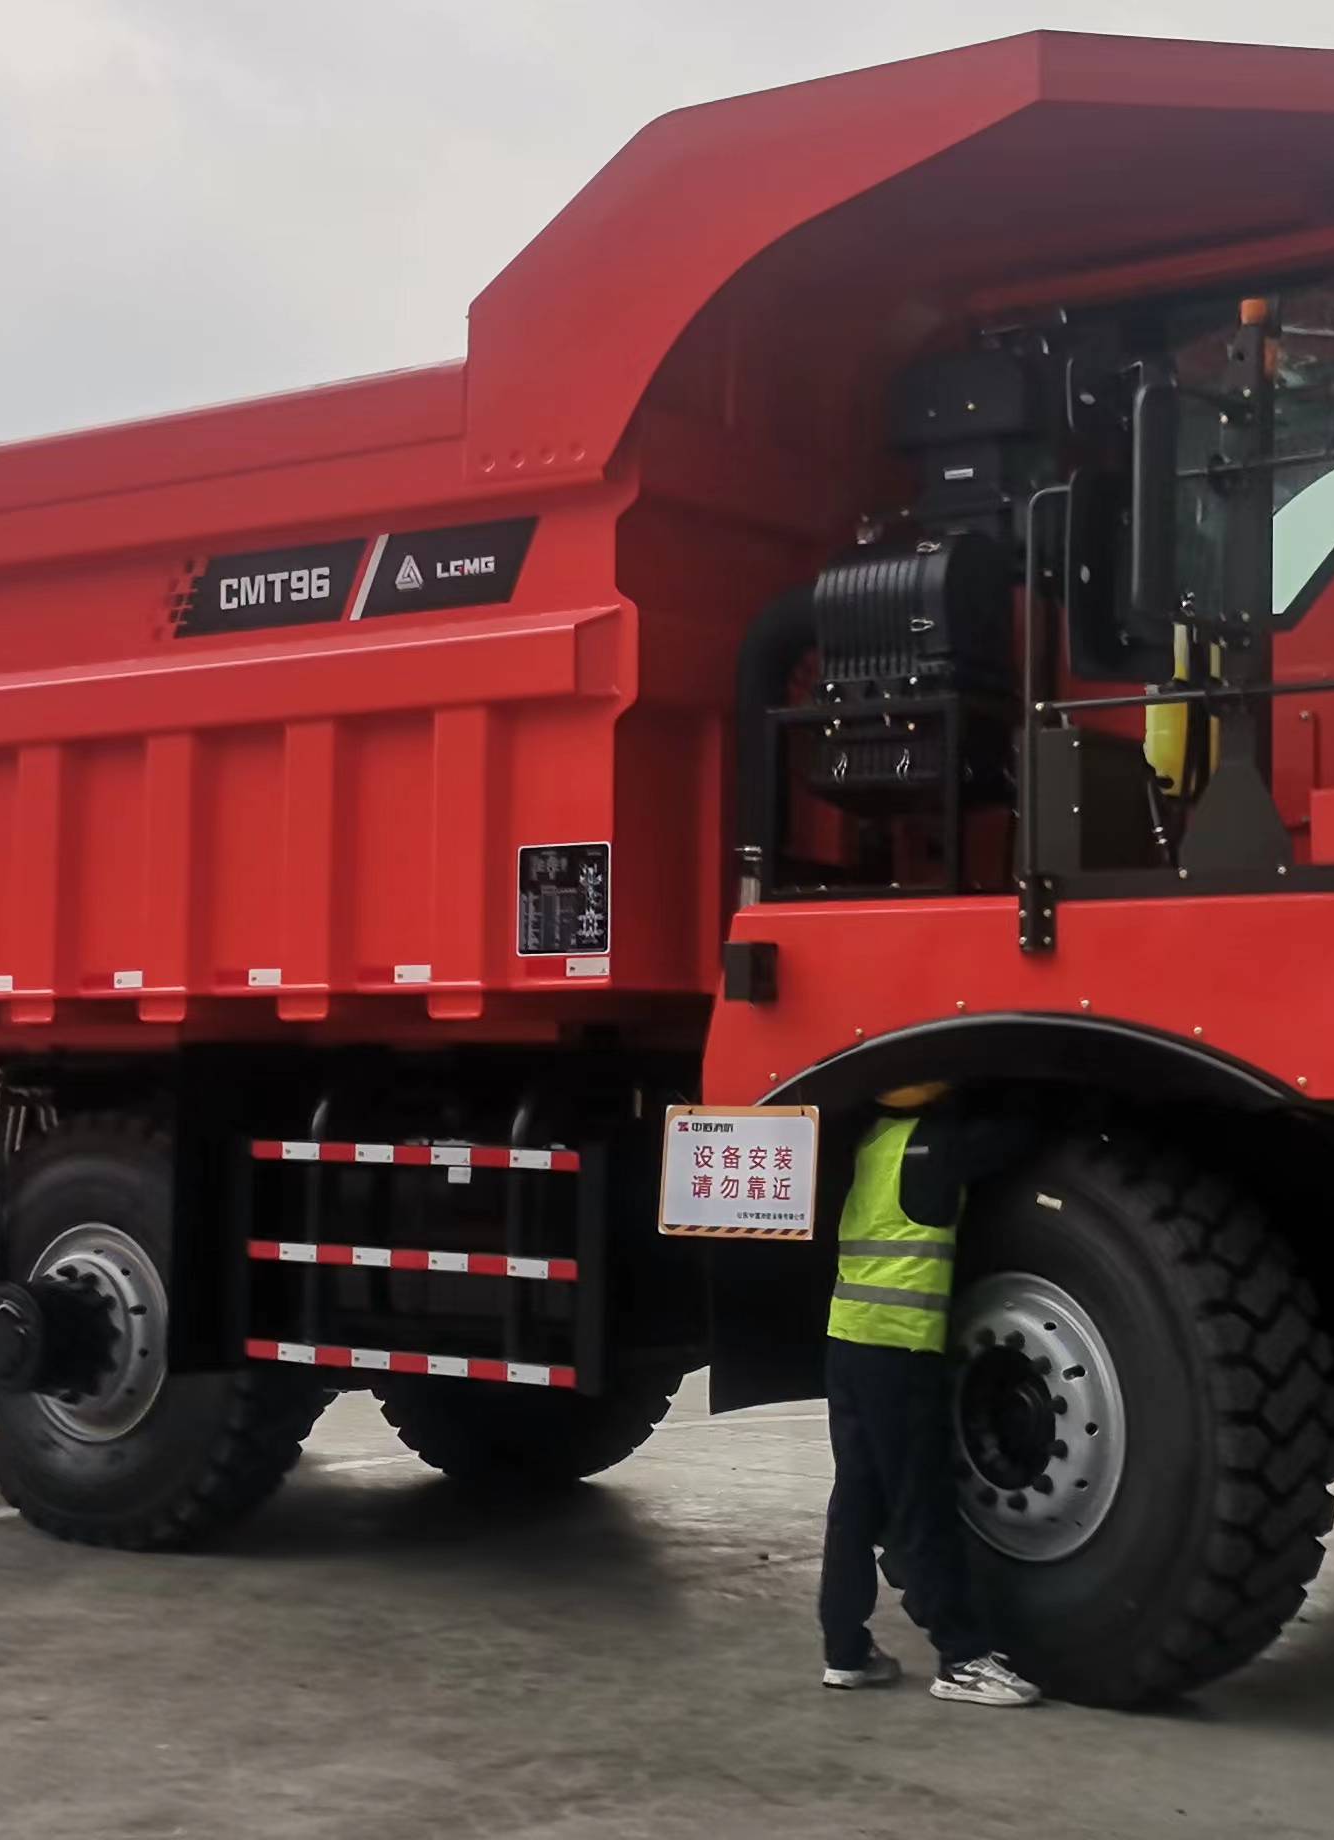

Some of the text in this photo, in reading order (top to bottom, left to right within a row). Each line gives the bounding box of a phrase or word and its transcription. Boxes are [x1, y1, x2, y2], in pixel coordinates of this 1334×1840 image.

[220, 566, 330, 610] CMT96
[693, 1145, 793, 1170] 设备安装
[691, 1174, 791, 1200] 请勿靠近
